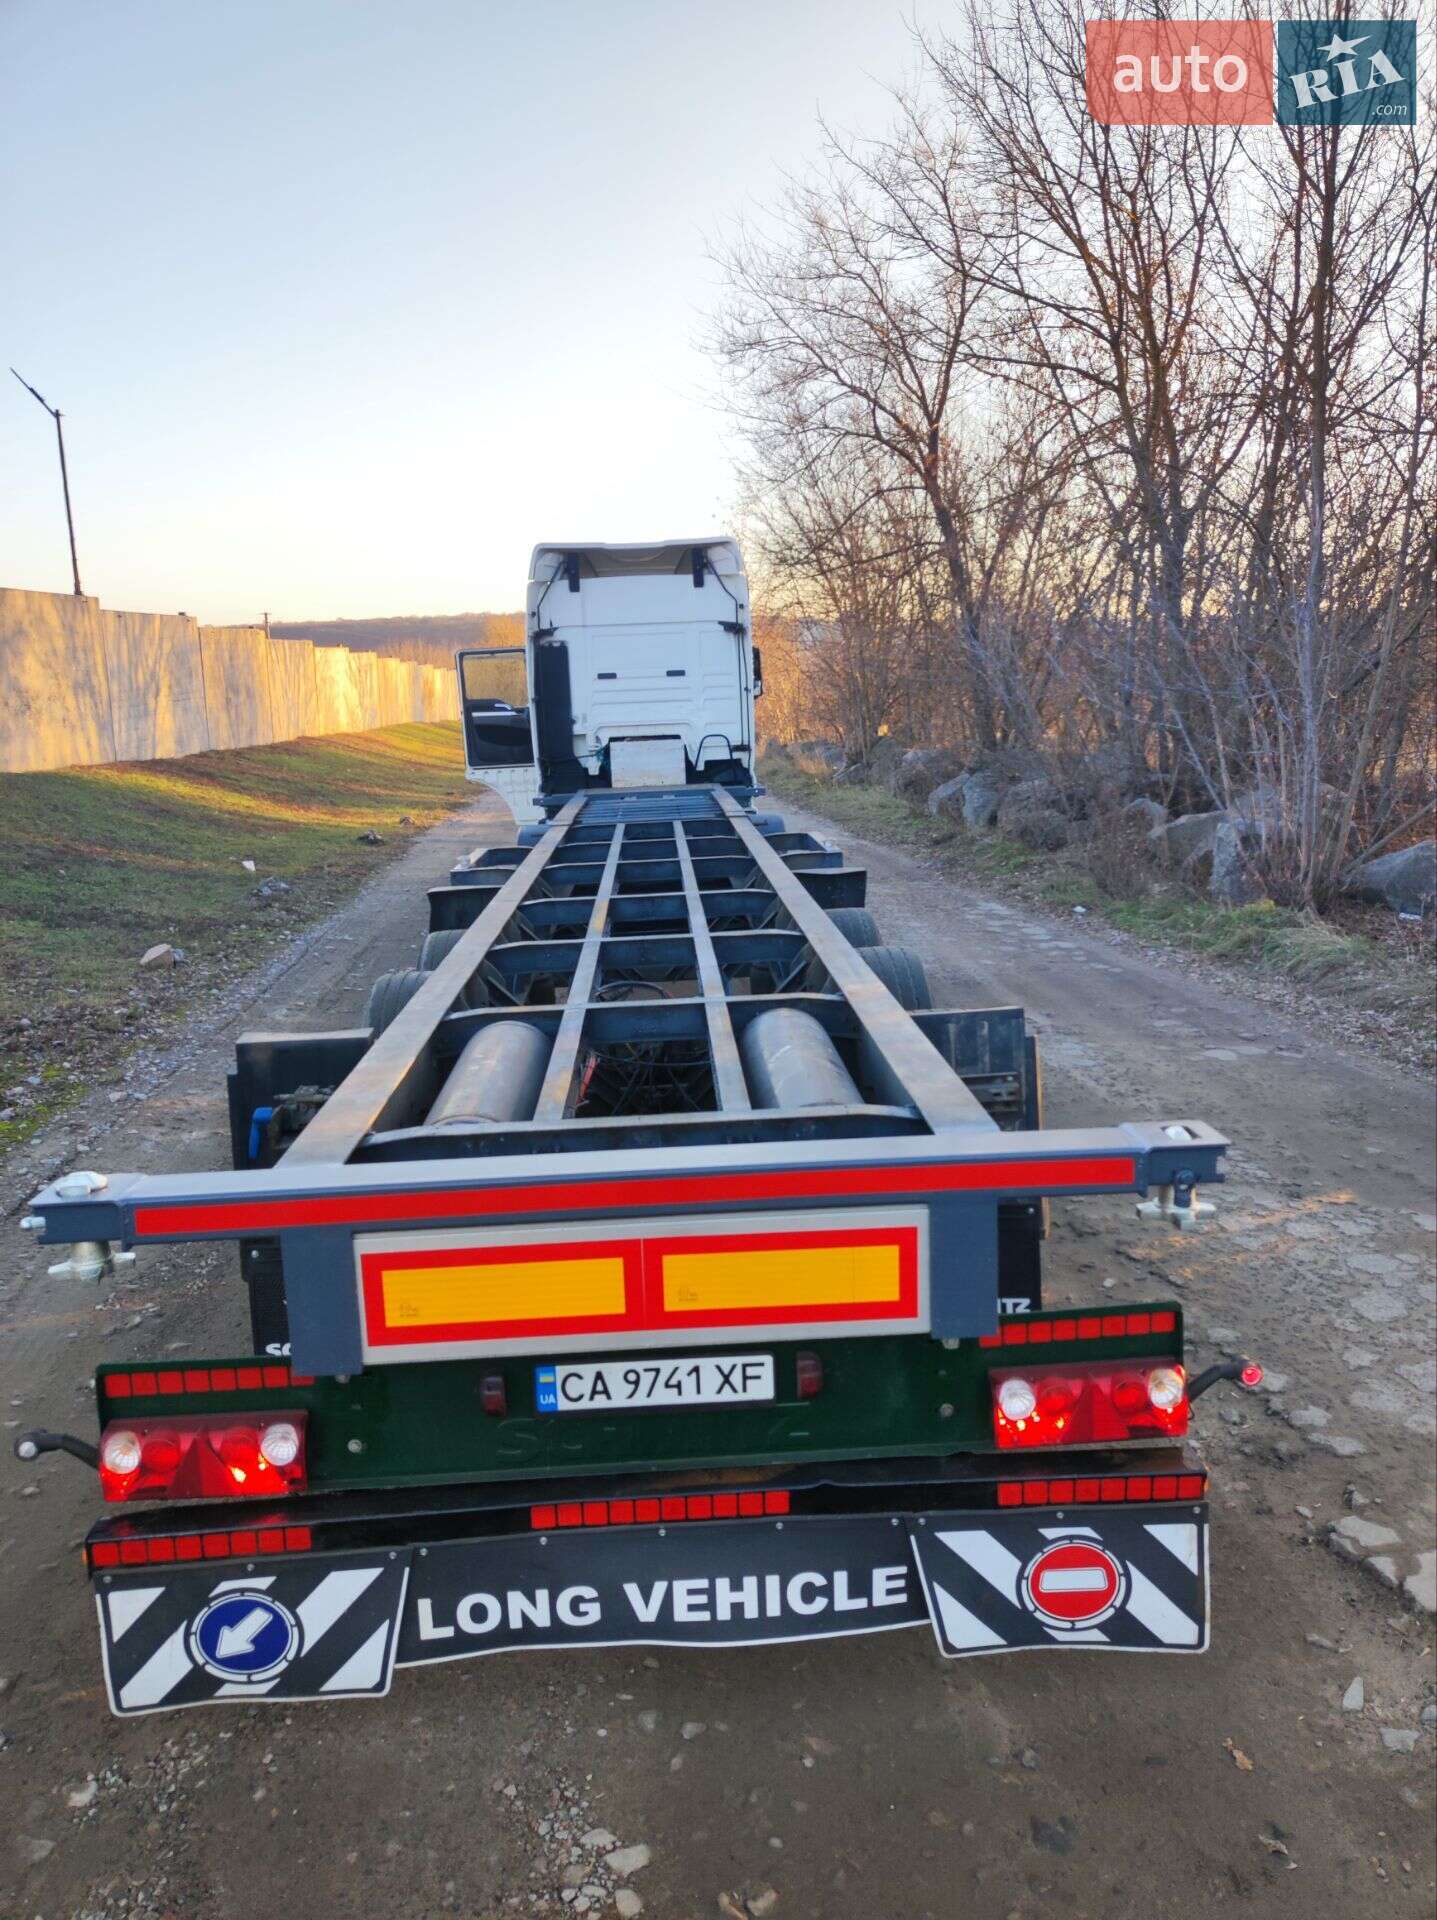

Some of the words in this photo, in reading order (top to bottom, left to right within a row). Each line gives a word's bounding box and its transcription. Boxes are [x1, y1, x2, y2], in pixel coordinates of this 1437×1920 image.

[540, 1393, 556, 1405] UA
[560, 1371, 612, 1403] CA
[623, 1365, 702, 1399] 9741
[714, 1361, 765, 1395] XF
[416, 1585, 601, 1640] LONG
[623, 1565, 909, 1622] VEHICLE
